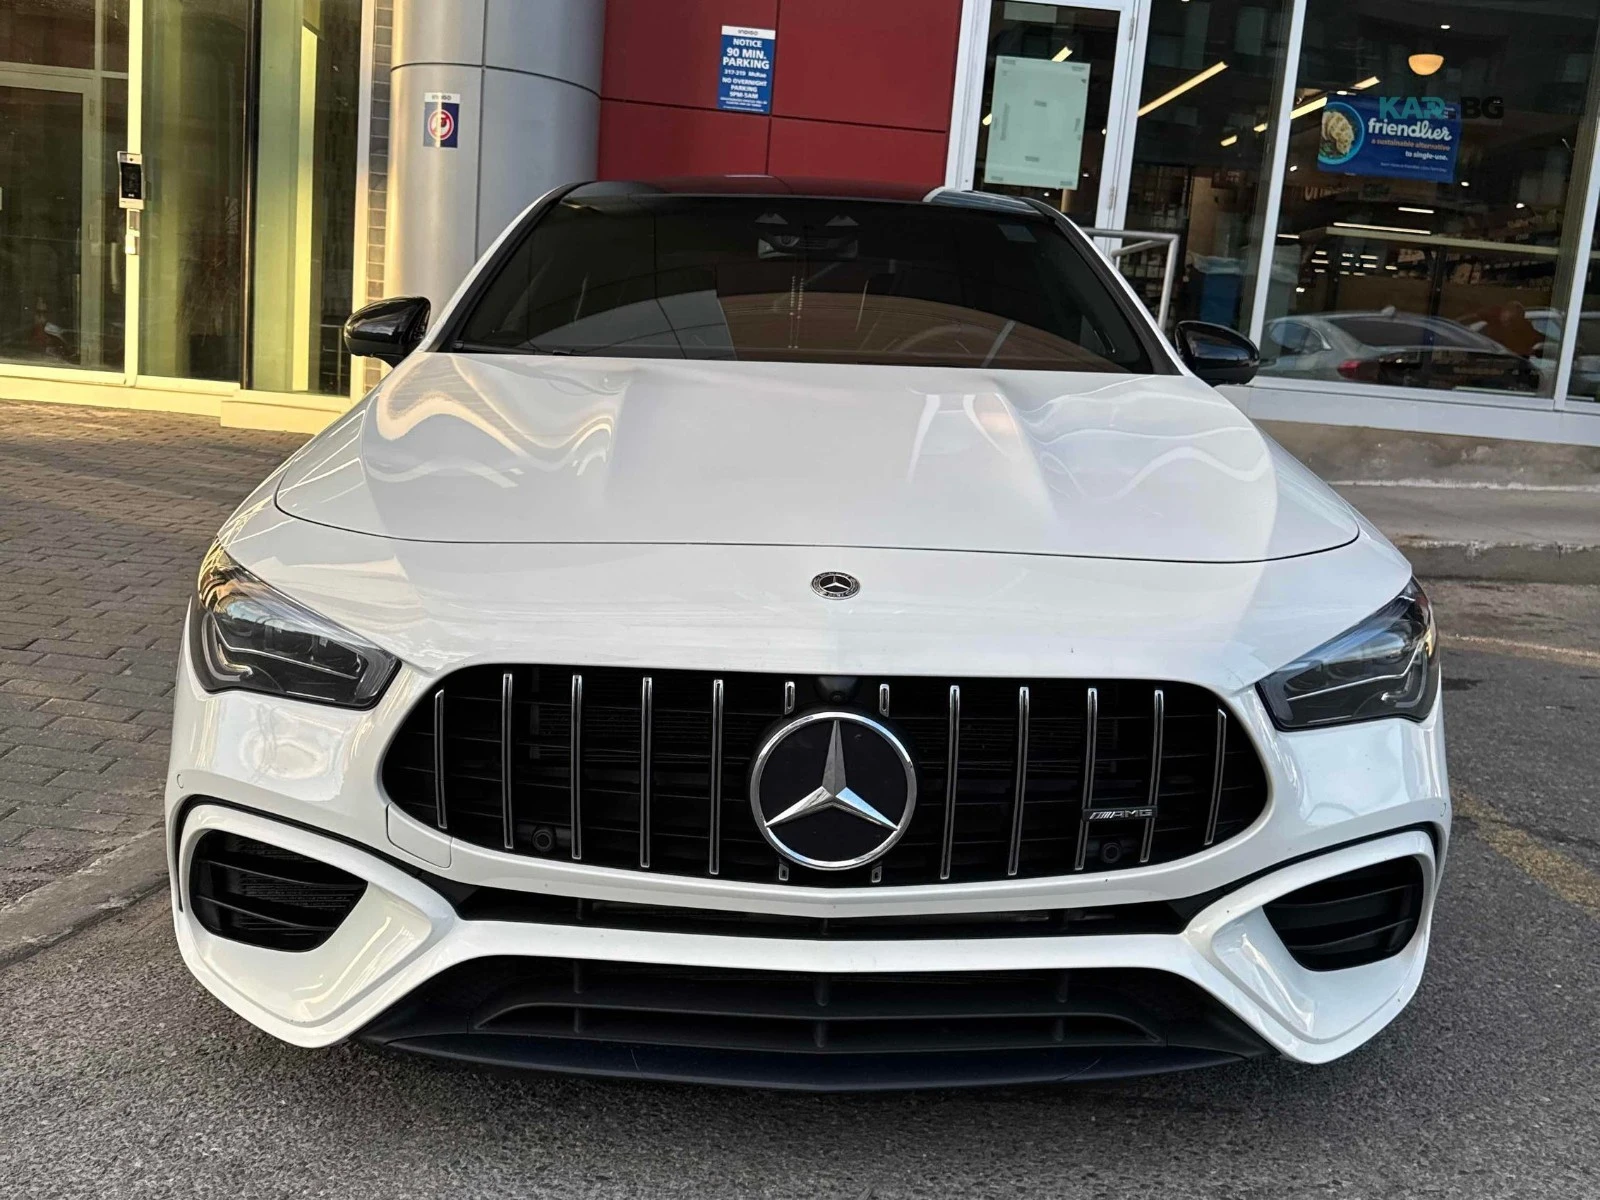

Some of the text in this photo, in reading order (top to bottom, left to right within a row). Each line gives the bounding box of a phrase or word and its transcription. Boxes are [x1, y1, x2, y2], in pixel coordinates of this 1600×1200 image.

[733, 39, 762, 47] NOTICE
[726, 47, 767, 59] 90 MIN.
[723, 57, 769, 69] PARKING
[731, 84, 757, 92] PARKING
[733, 78, 767, 86] OVERNIGHT
[1368, 117, 1452, 140] friendlier
[1377, 139, 1414, 147] sustainable
[1415, 142, 1451, 151] alternative
